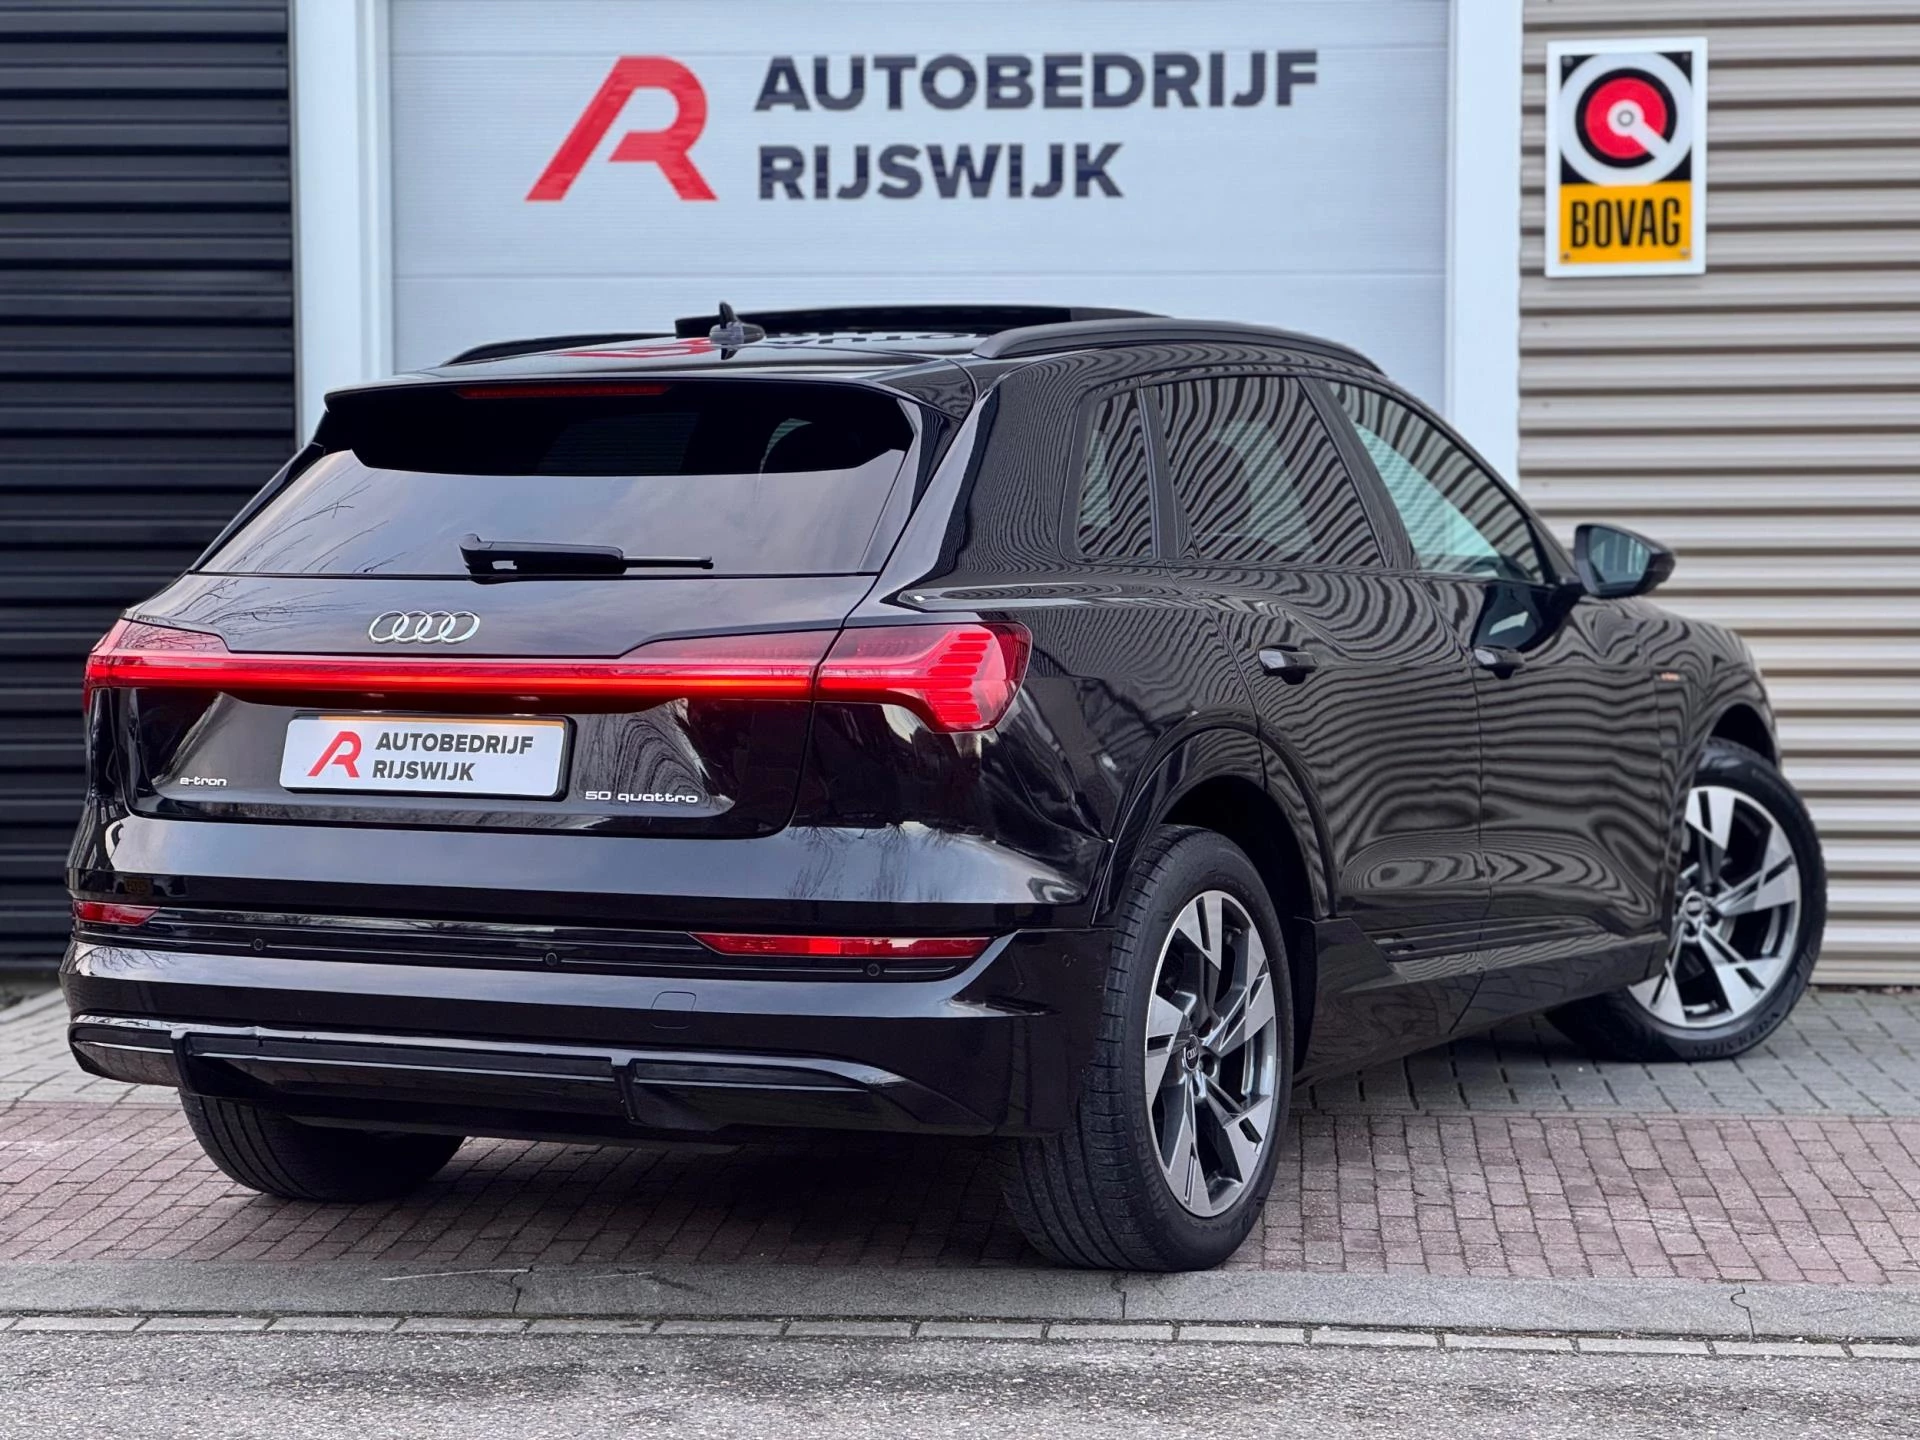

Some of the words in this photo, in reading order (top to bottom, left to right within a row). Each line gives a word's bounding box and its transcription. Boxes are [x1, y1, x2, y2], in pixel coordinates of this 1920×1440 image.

[754, 50, 1318, 112] AUTOBEDRIJF
[759, 143, 1123, 200] RIJSWIJK
[1571, 197, 1681, 249] BOVAG
[375, 732, 534, 755] AUTOBEDRIJF
[180, 776, 227, 786] e-tron
[372, 760, 475, 781] RIJSWIJK
[584, 791, 611, 800] 50
[617, 792, 698, 803] quattro
